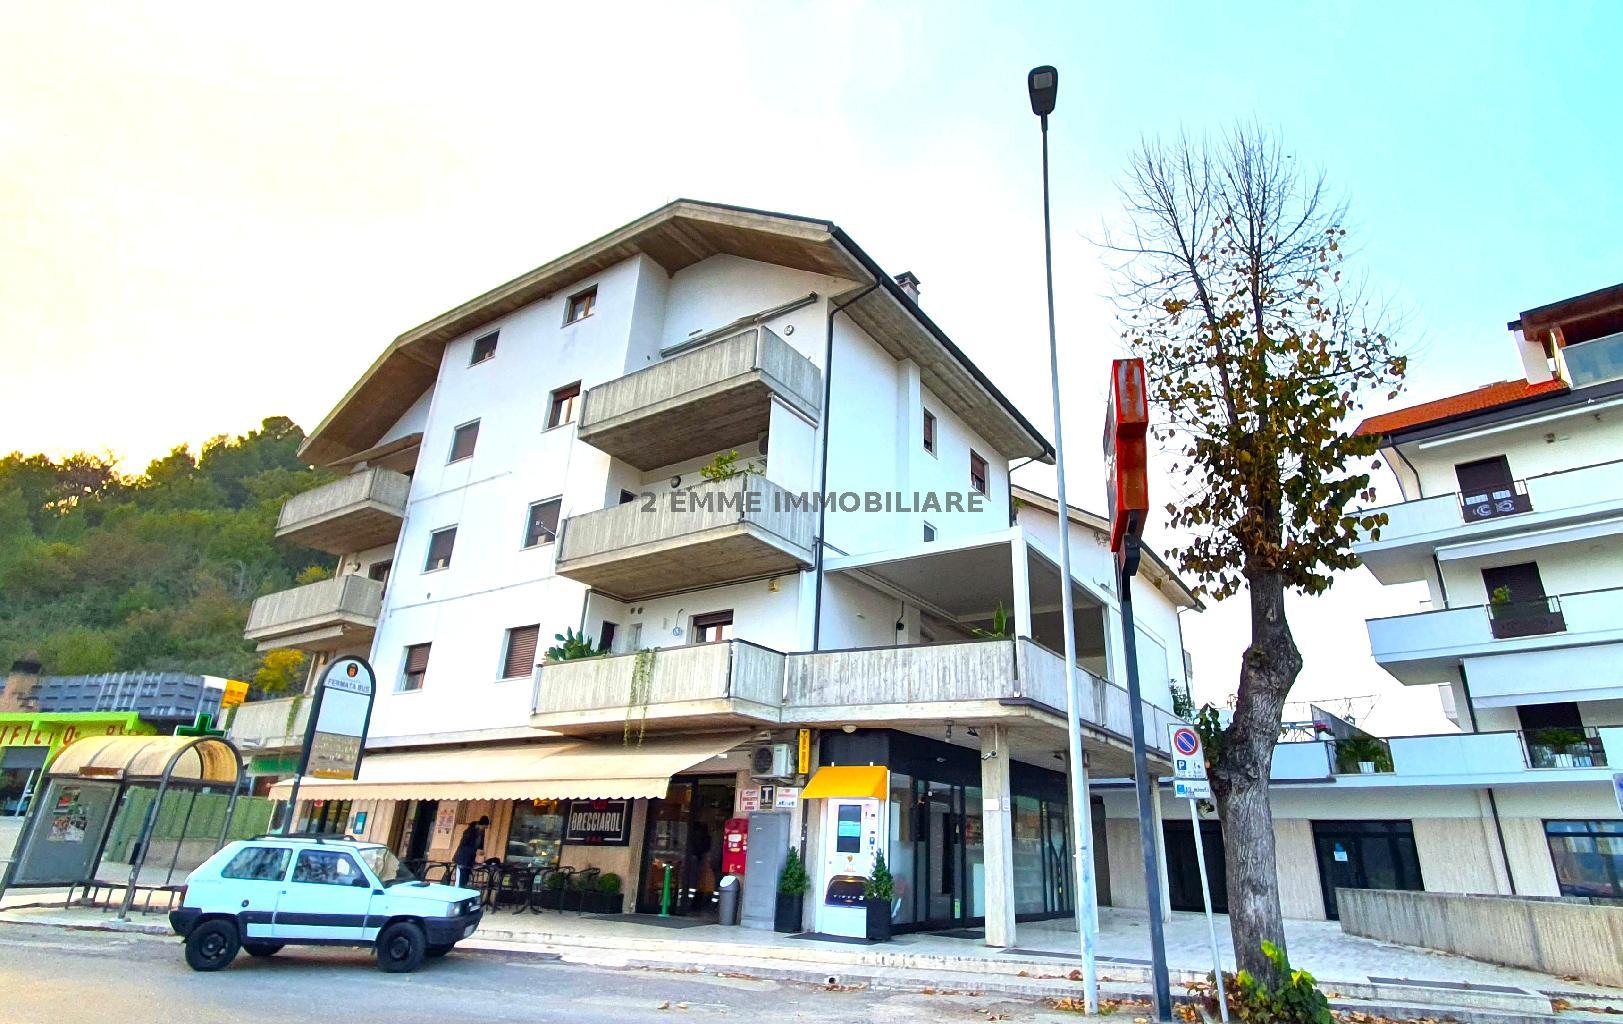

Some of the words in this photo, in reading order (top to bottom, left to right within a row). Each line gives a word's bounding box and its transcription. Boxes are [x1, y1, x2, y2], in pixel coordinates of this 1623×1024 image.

[327, 678, 357, 690] FERMATA
[358, 684, 370, 693] BUS
[762, 787, 773, 803] T
